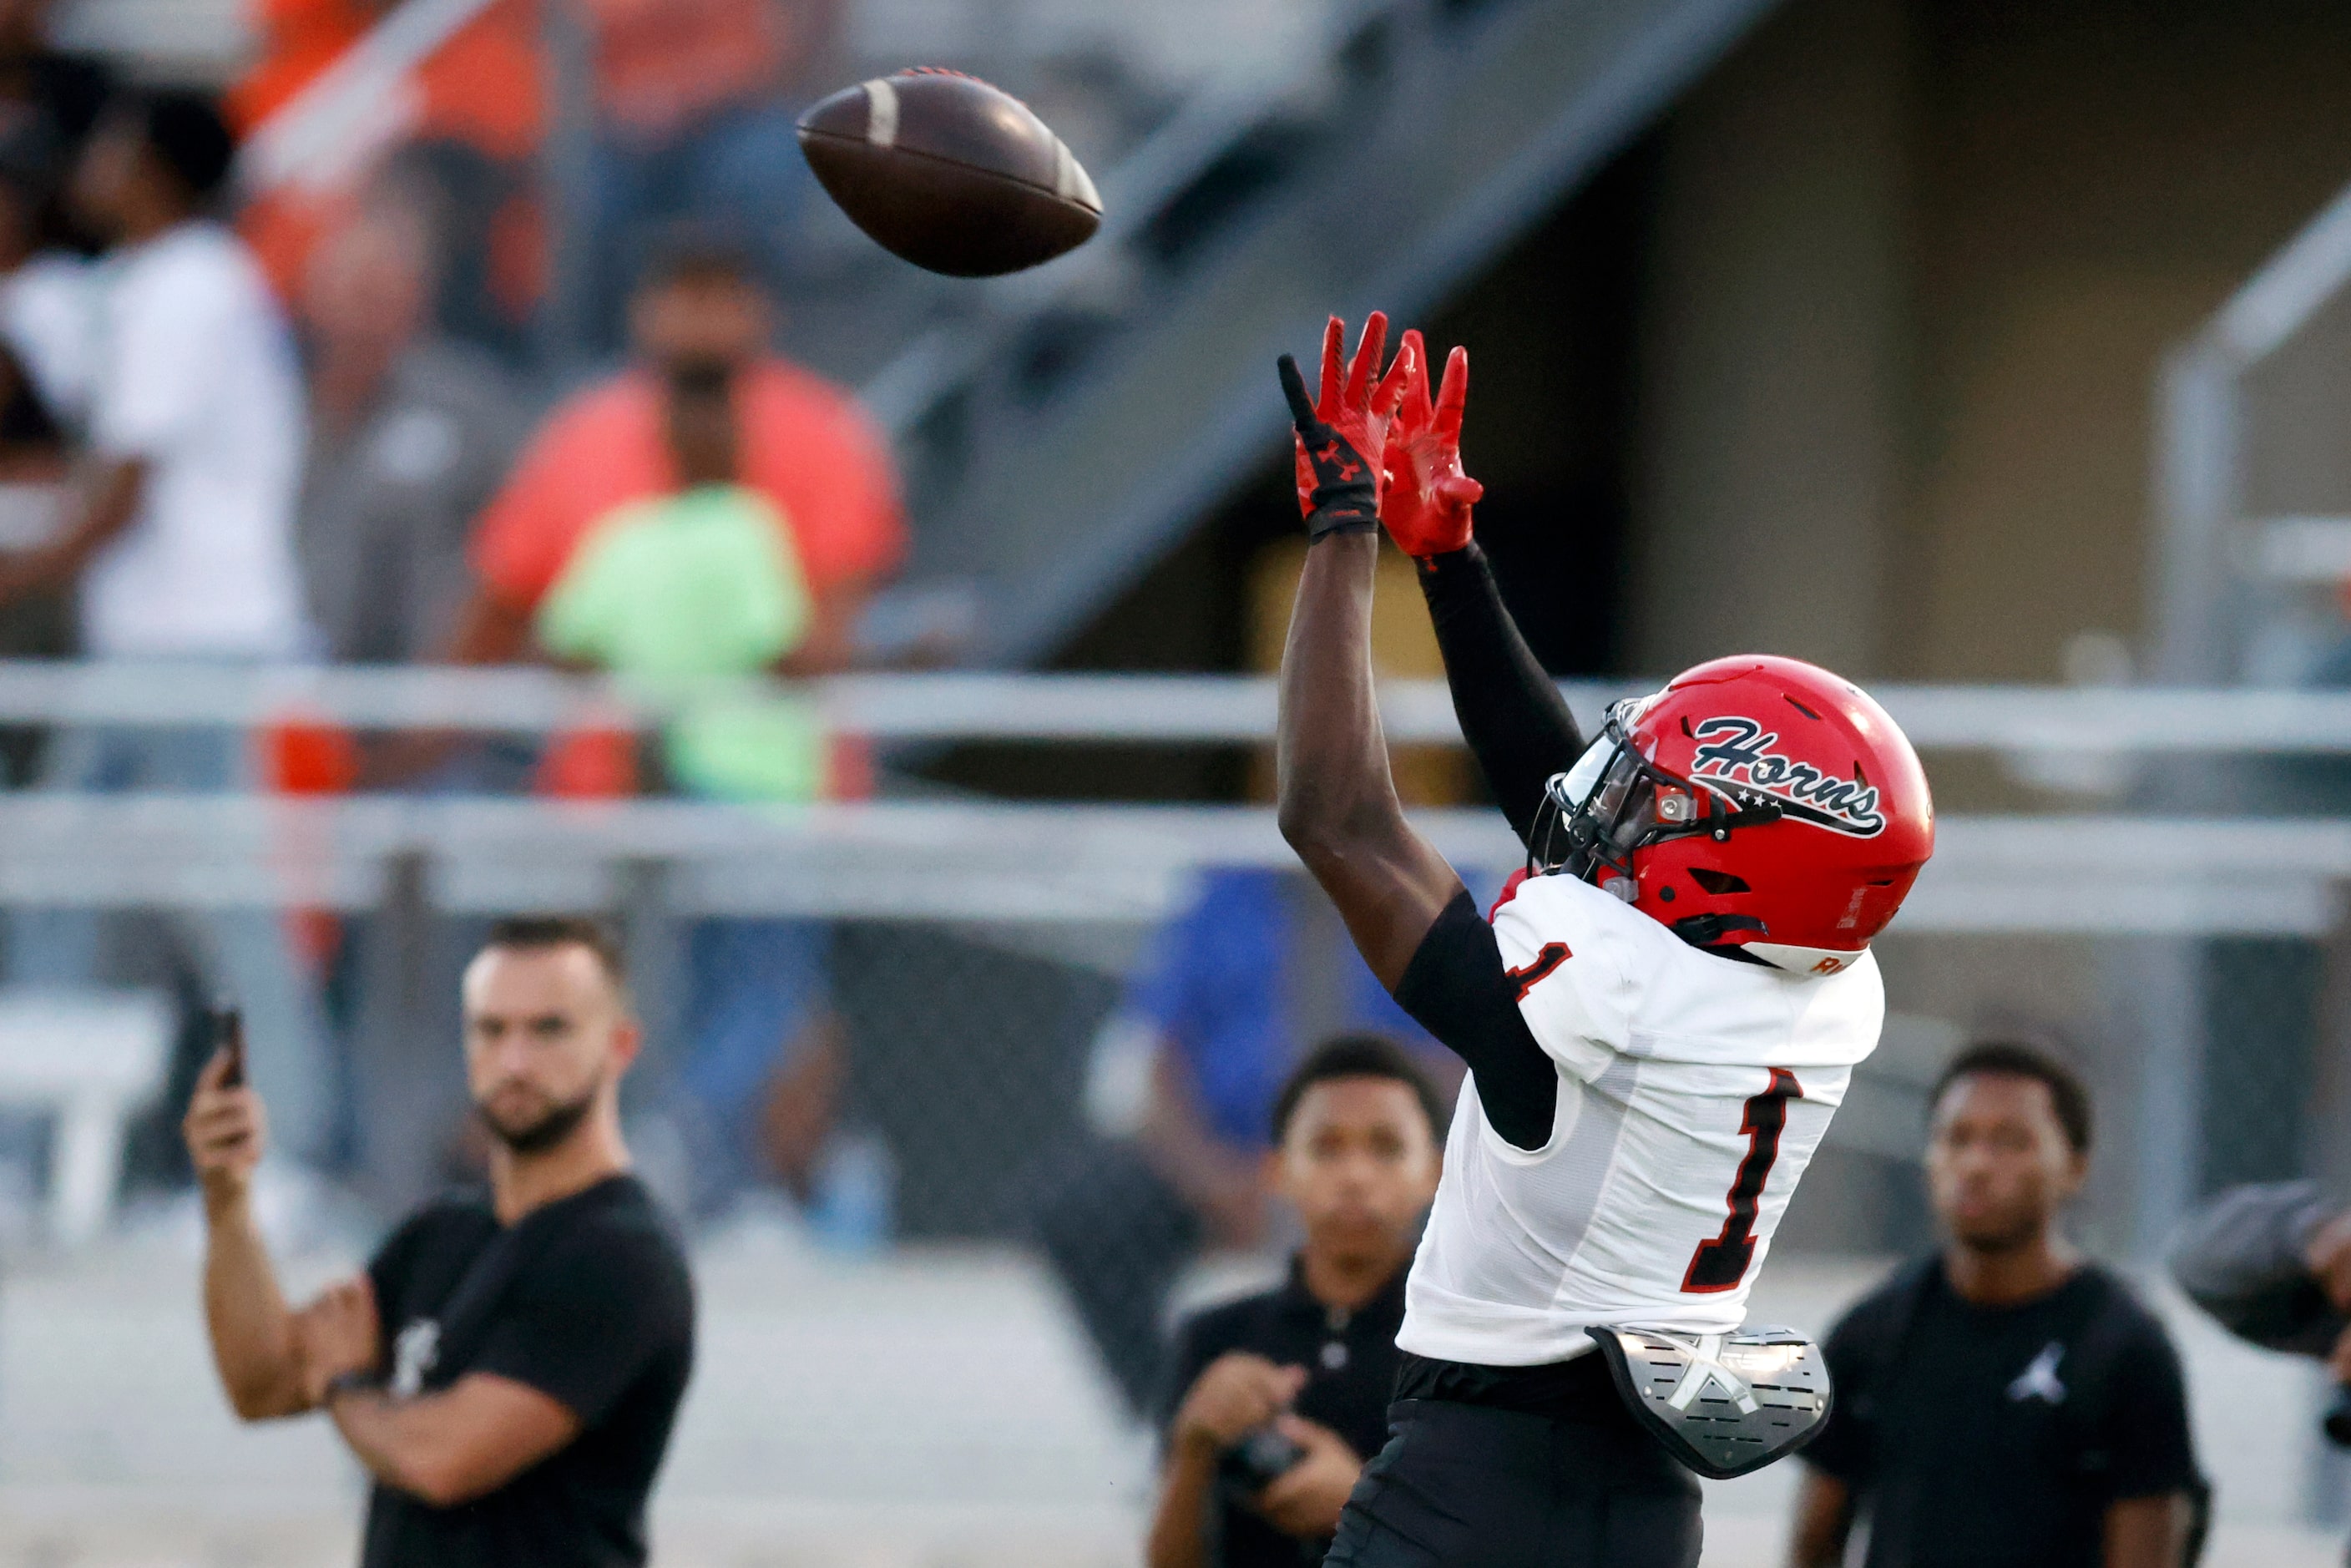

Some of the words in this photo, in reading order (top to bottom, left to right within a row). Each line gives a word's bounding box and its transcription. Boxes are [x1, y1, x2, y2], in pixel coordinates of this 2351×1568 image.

[1691, 716, 1886, 837] Horns
[1504, 942, 1573, 1002] 1
[1680, 1067, 1803, 1293] 1
